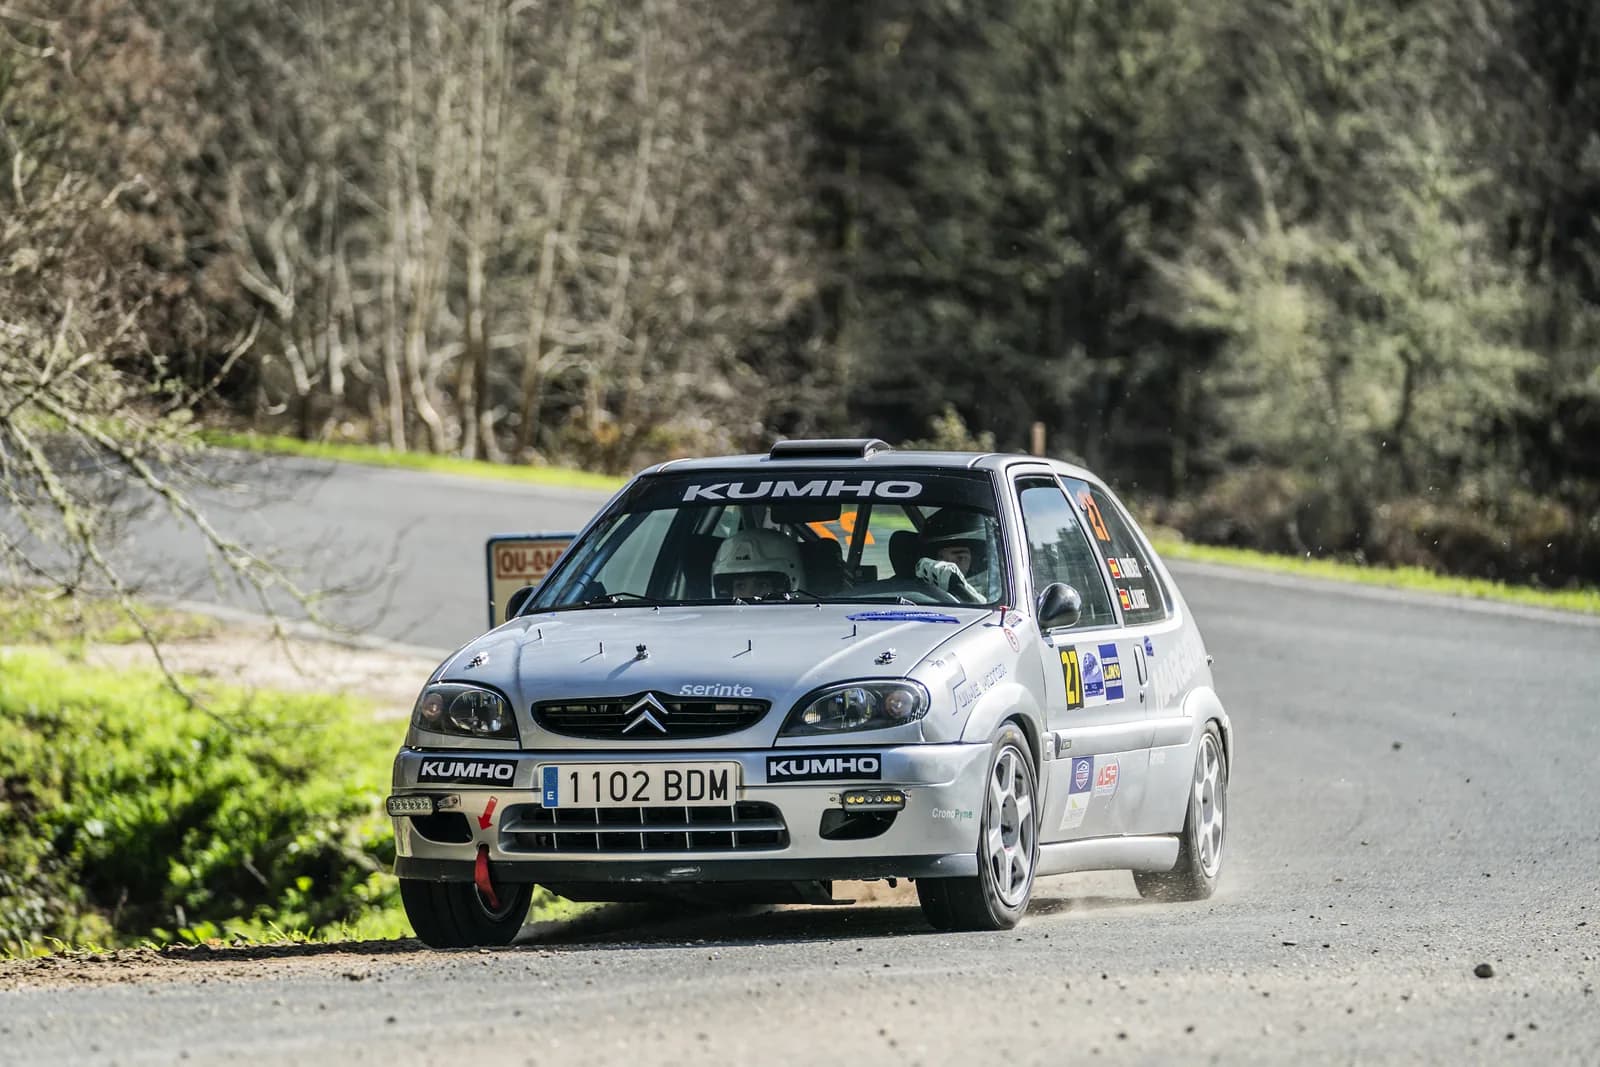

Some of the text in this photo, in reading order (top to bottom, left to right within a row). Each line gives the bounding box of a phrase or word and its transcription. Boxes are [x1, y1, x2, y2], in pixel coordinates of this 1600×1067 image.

[682, 480, 923, 502] KUMHO
[1061, 651, 1080, 705] 27
[679, 683, 753, 697] serinte
[421, 761, 514, 780] KUMHO
[769, 757, 879, 776] KUMHO
[547, 791, 555, 800] E
[570, 769, 728, 803] 1102 BDM
